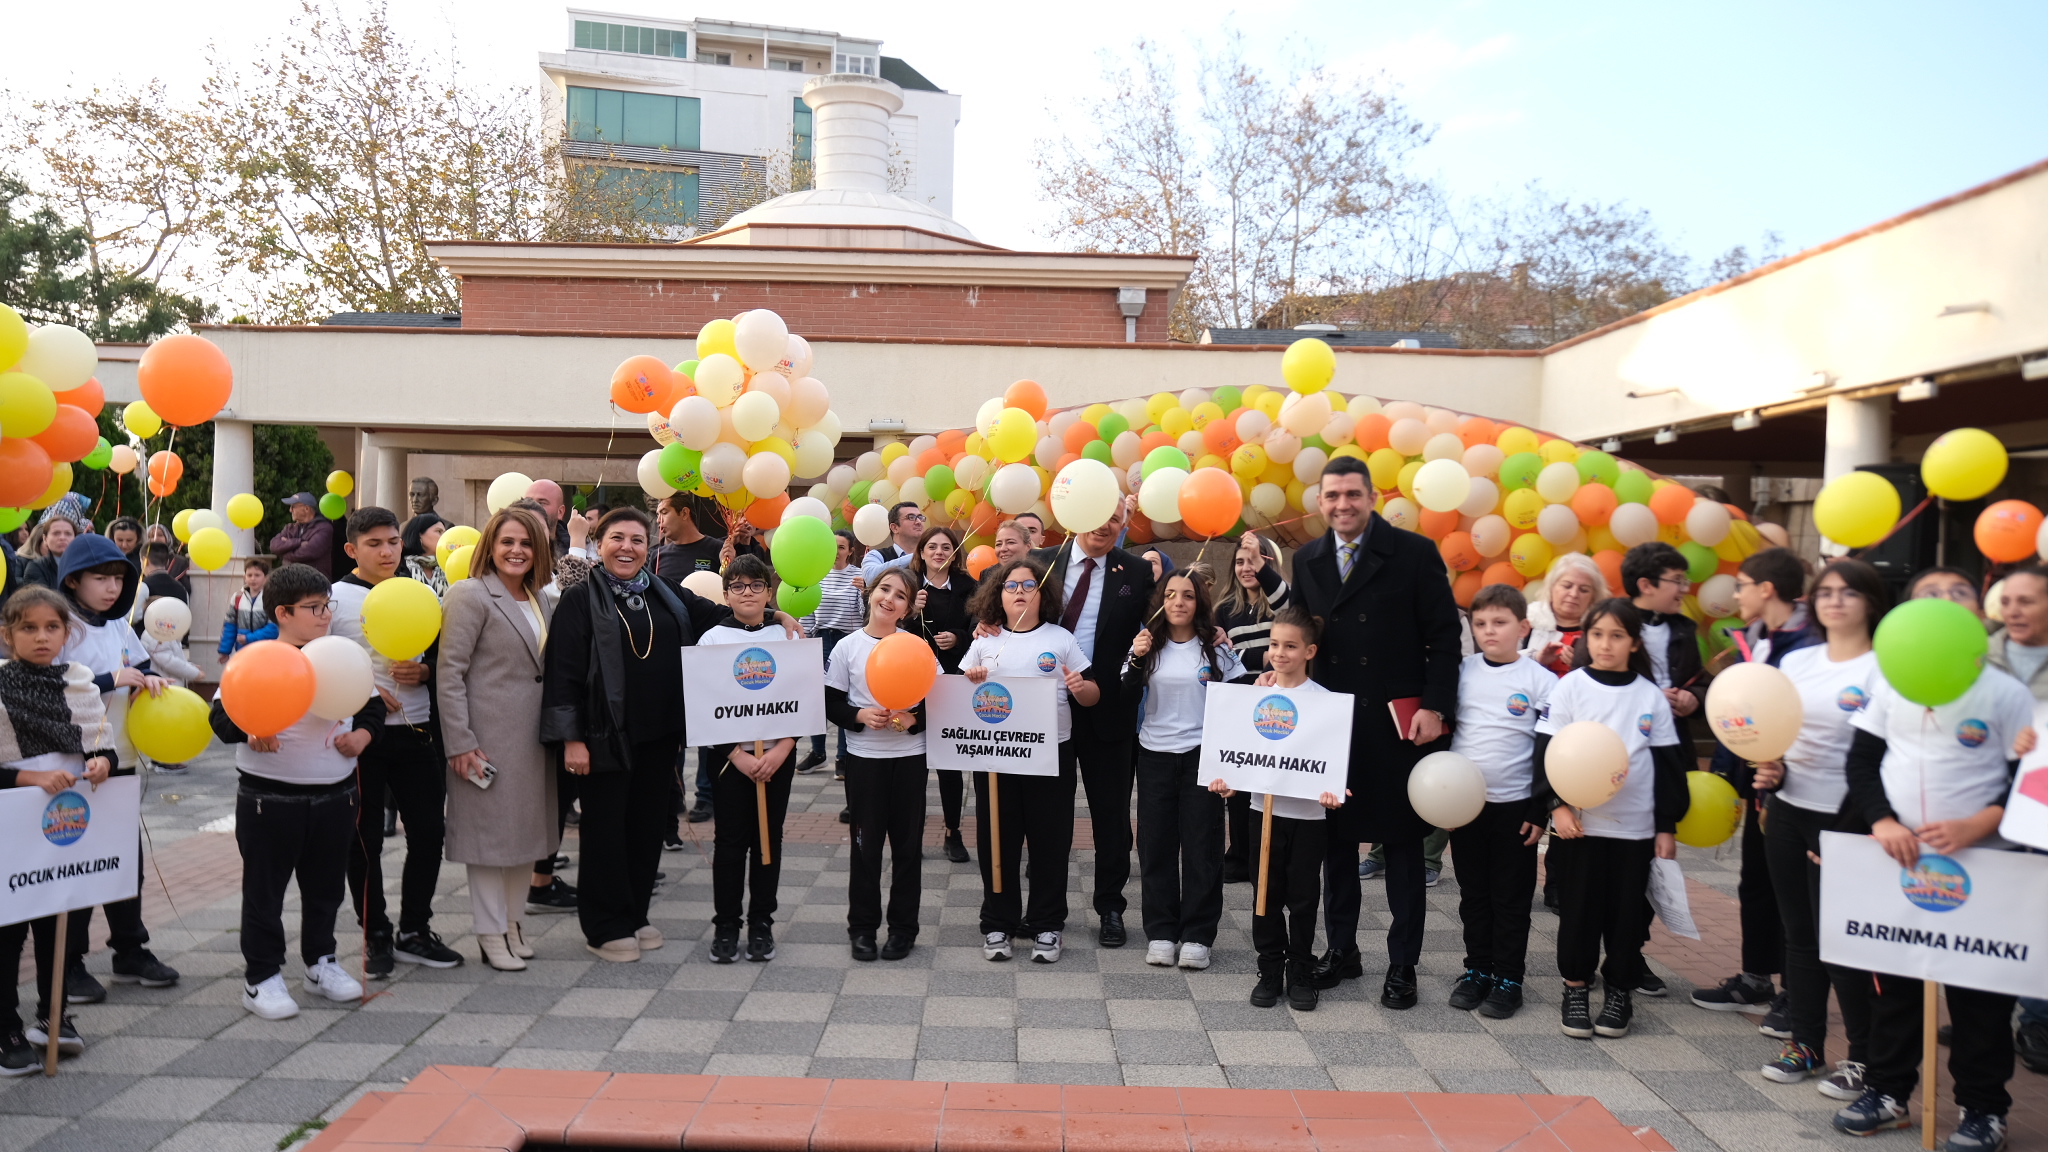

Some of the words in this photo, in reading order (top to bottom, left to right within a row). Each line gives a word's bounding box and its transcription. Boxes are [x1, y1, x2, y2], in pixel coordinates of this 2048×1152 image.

[714, 704, 754, 720] OYUN
[756, 700, 799, 716] HAKKI
[941, 726, 992, 741] SAĞLIKLI
[993, 730, 1046, 745] ÇEVREDE
[955, 743, 994, 758] YAŞAM
[996, 746, 1032, 758] HAKKI
[1219, 749, 1276, 769] YAŞAMA
[1278, 756, 1327, 774] HAKKI
[9, 866, 56, 893] ÇOCUK
[57, 856, 120, 879] HAKLIDIR
[1845, 919, 1948, 950] BARINMA
[1954, 935, 2029, 962] HAKKI
